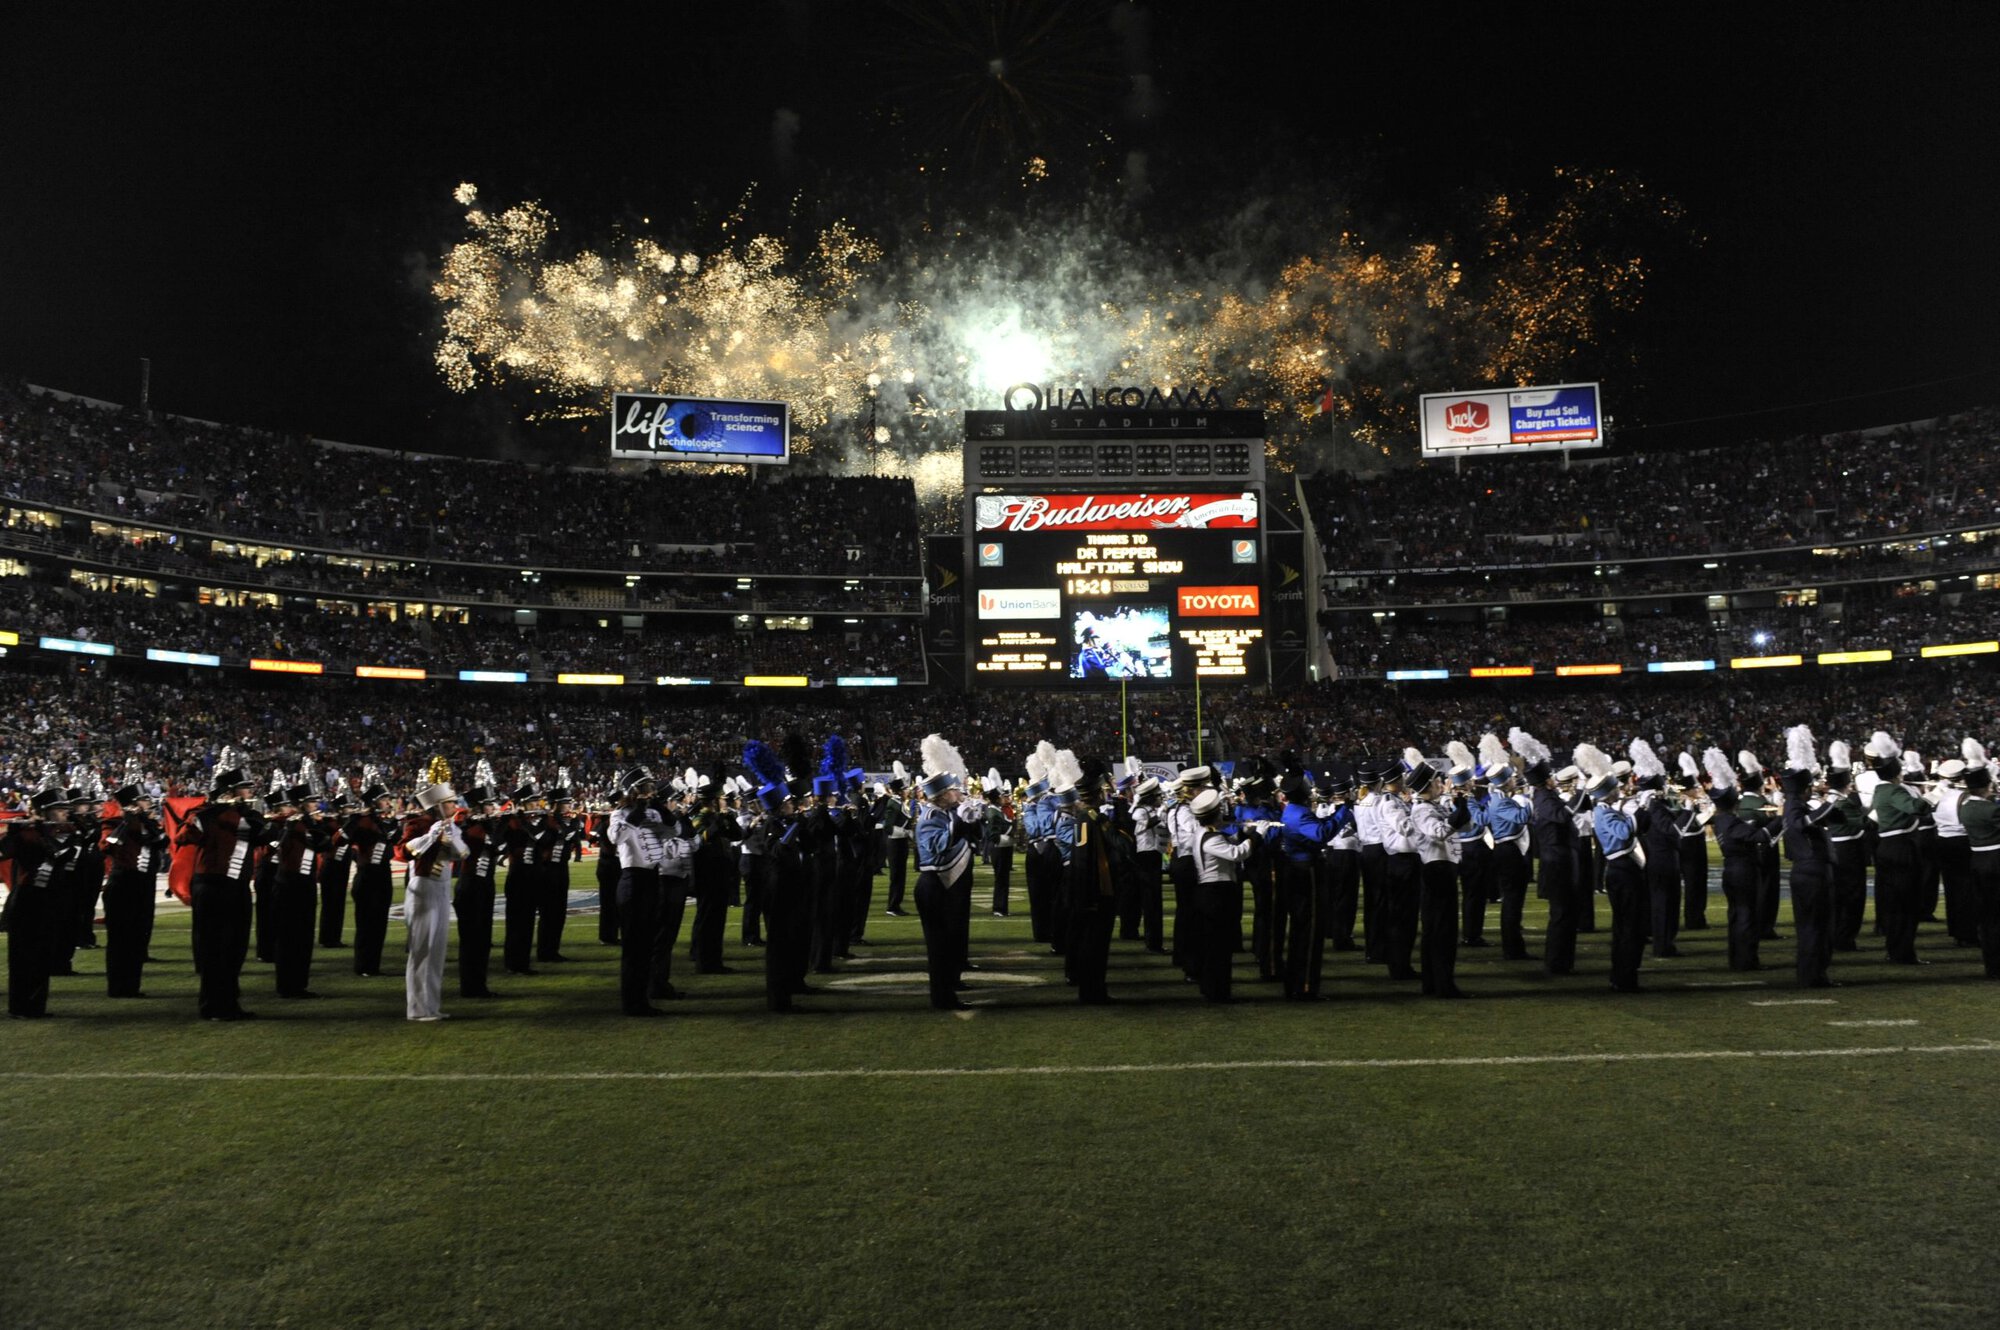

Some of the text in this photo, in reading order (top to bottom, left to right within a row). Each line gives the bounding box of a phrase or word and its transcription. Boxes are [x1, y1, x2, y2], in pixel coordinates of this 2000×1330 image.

[1004, 382, 1224, 411] QUALCOMM
[1447, 403, 1488, 429] Jack
[1526, 405, 1579, 418] Buy and Sell
[617, 400, 675, 449] life
[710, 412, 779, 426] Transforming
[1051, 418, 1207, 428] STADIUM
[1515, 416, 1591, 430] Chargers Tickets!
[725, 422, 764, 433] science
[658, 438, 722, 449] technologies
[1001, 494, 1190, 531] Budweiser
[1086, 534, 1148, 545] THANKS TO
[1076, 546, 1157, 560] DR PEPPER
[1056, 561, 1183, 574] HALFTIME SHOW
[929, 593, 961, 606] Sprint
[1182, 594, 1256, 609] TOYOTA
[1272, 590, 1304, 602] Sprint
[1000, 600, 1059, 609] UnionBank
